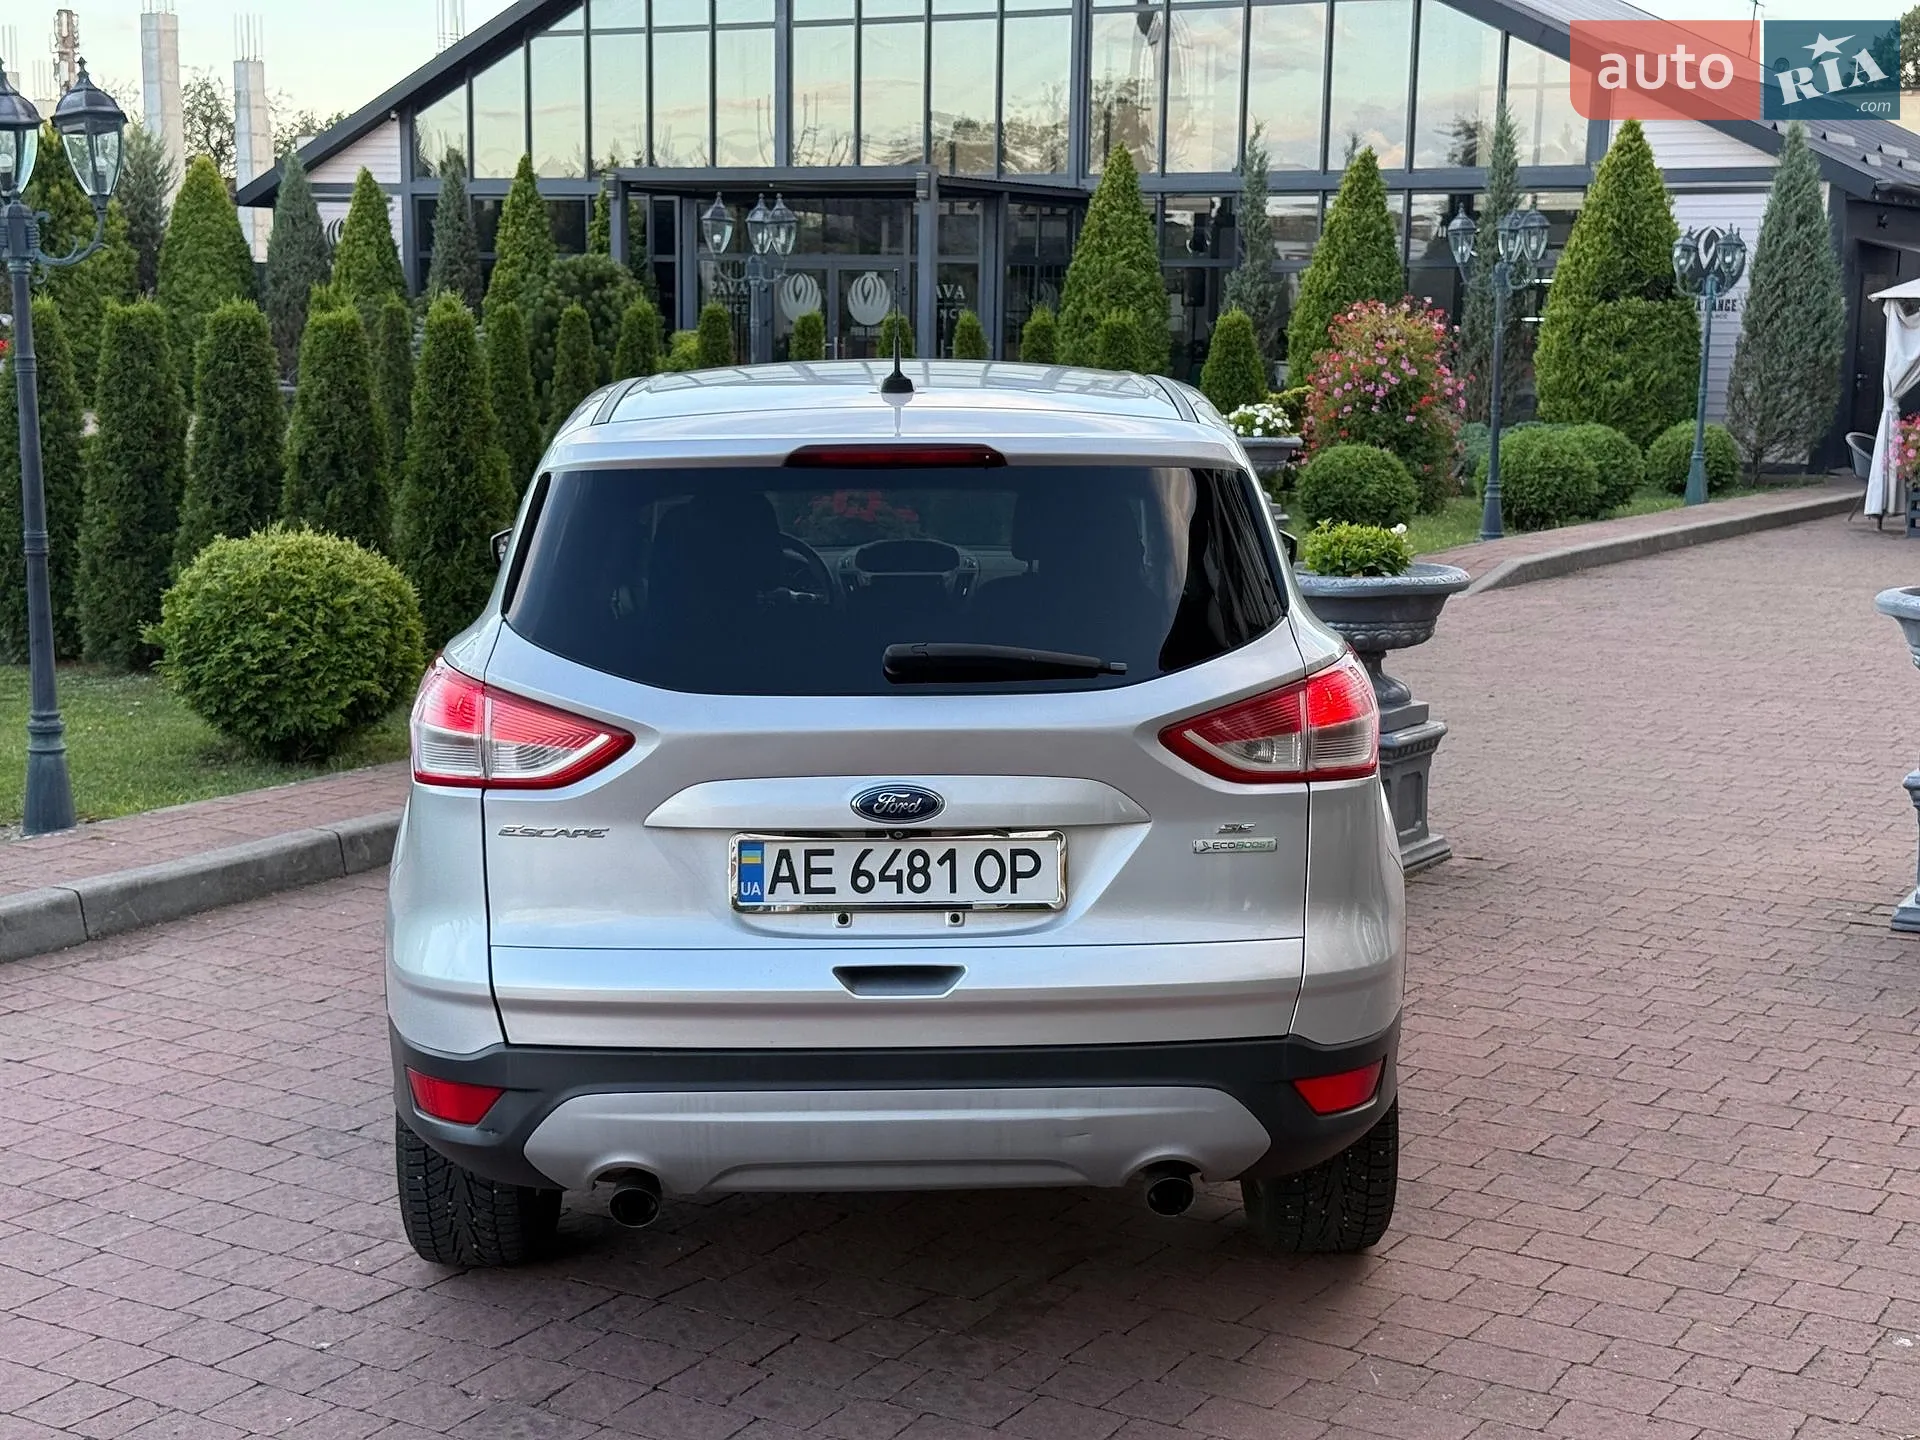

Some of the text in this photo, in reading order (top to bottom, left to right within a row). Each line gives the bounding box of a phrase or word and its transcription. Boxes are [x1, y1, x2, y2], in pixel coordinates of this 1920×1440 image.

[873, 792, 922, 814] Ford
[498, 824, 610, 839] ESCAPE
[1212, 840, 1275, 851] ECOBOOST
[768, 848, 1042, 894] AE 6481 OP
[741, 881, 762, 896] UA
